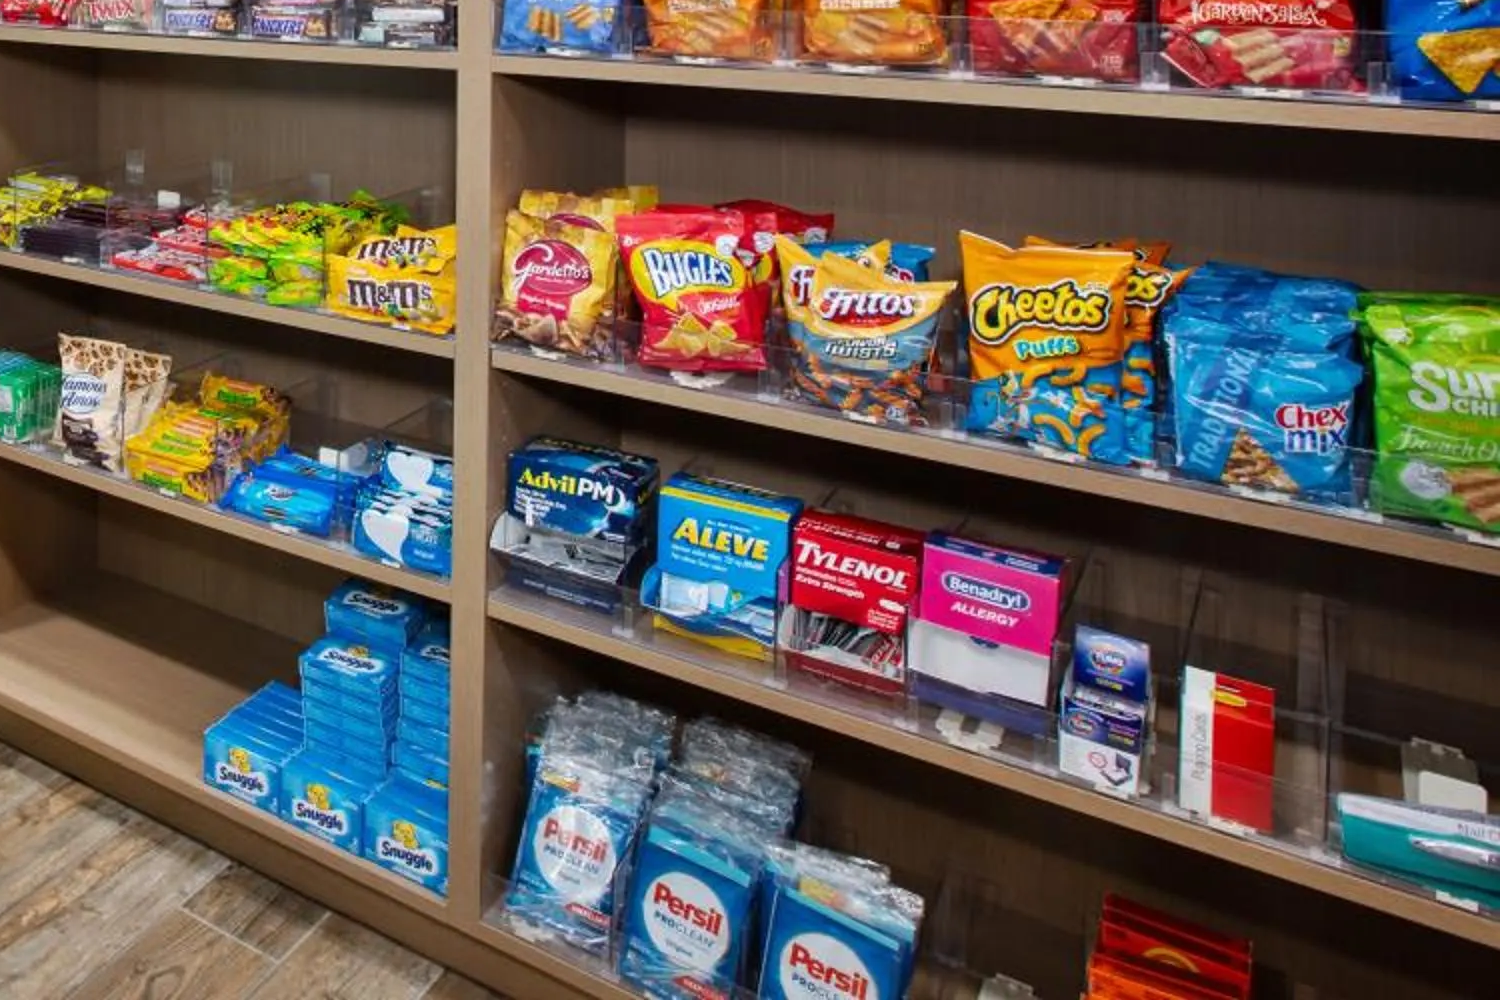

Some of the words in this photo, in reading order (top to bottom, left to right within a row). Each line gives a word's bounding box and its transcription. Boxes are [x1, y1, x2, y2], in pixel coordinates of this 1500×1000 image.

[642, 247, 734, 299] BUGLES
[821, 287, 917, 321] Fritos
[972, 280, 1109, 342] Cheetos
[1013, 335, 1080, 361] Puffs
[1275, 400, 1349, 429] Chex
[1284, 427, 1348, 455] mix
[518, 467, 577, 495] Advil
[577, 477, 615, 505] PM
[672, 517, 770, 561] ALEVE
[796, 537, 908, 590] TYLENOL
[348, 591, 400, 614] Snuggle
[949, 575, 1022, 609] Benadryl
[949, 600, 1020, 628] ALLERGY
[323, 648, 376, 672] Snuggle
[219, 765, 266, 793] Snuggle
[295, 802, 344, 833] Snuggle
[380, 841, 434, 873] Snuggle
[543, 817, 608, 864] Persil
[653, 881, 724, 937] Persil
[788, 941, 870, 1000] Persil
